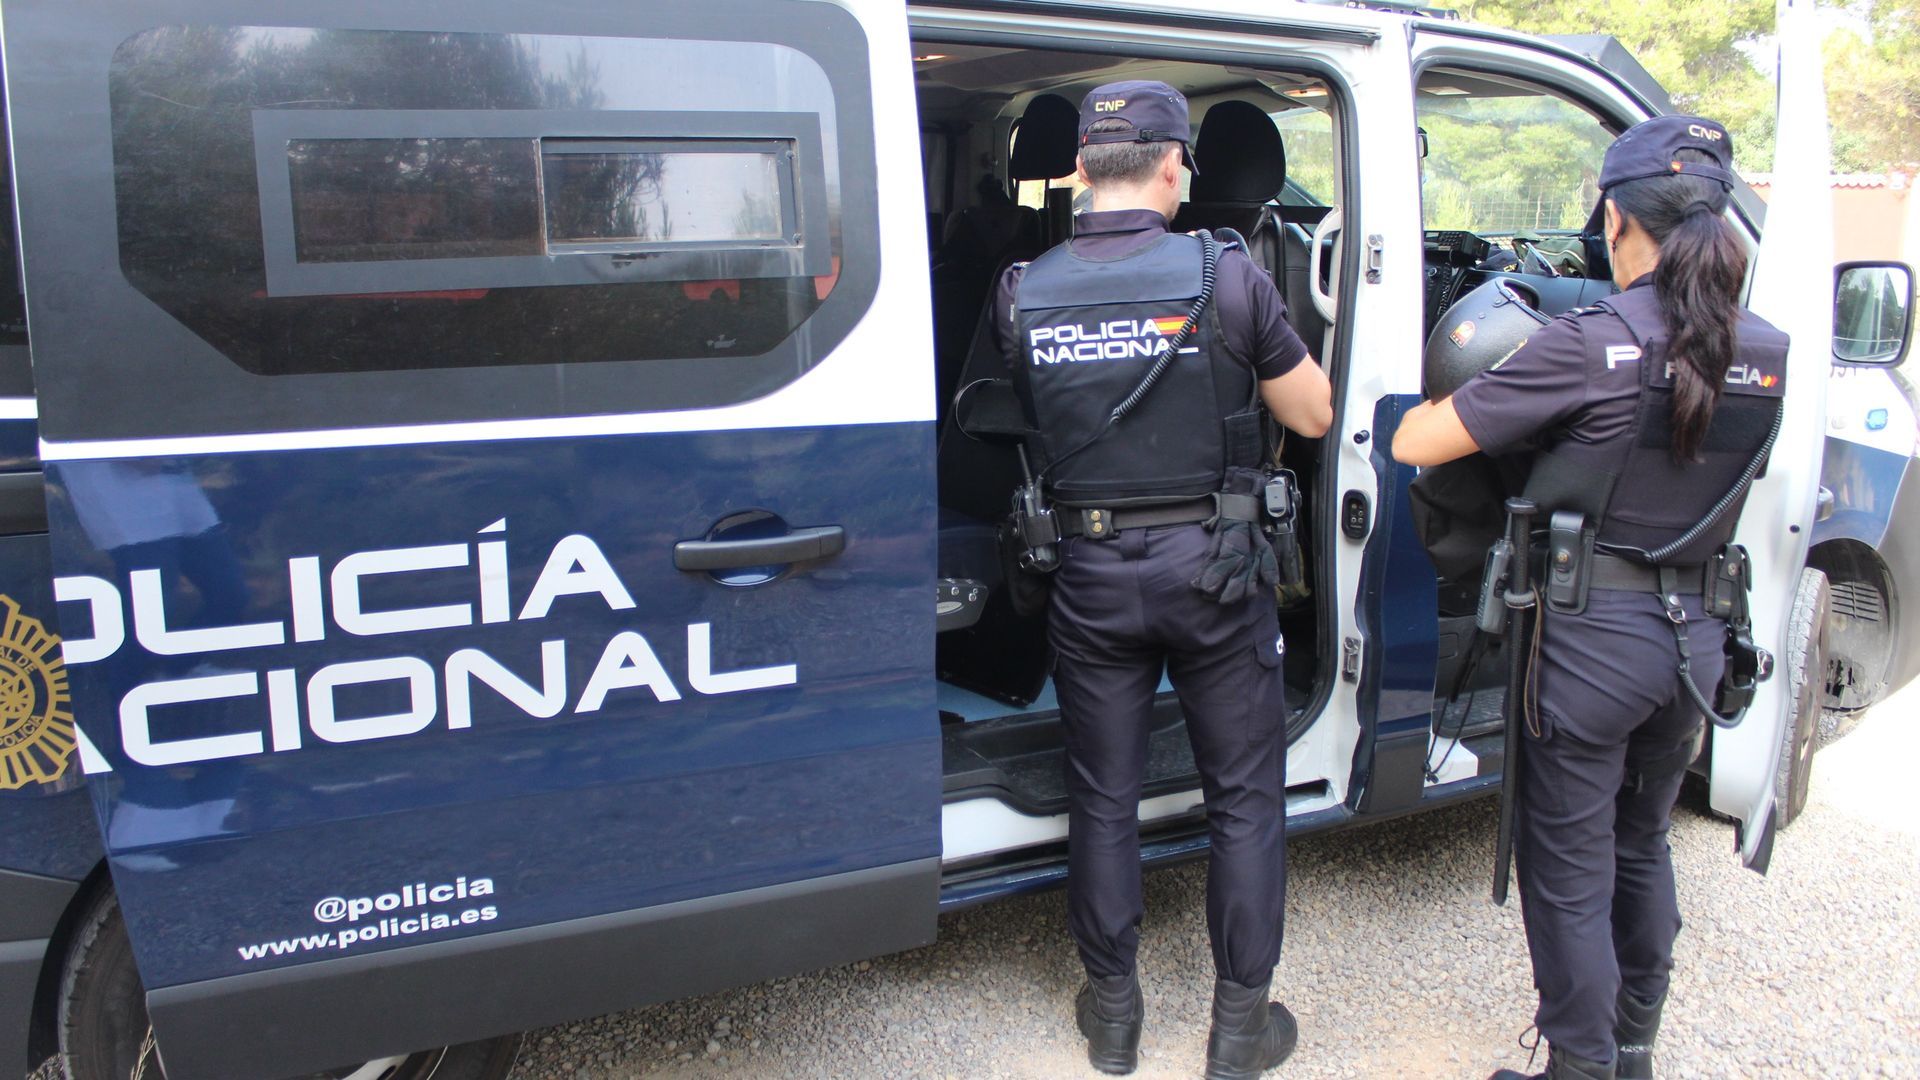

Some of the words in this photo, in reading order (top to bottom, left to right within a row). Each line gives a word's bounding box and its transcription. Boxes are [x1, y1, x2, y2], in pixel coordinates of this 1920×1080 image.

[1094, 99, 1126, 112] CNP
[1688, 124, 1722, 141] CNP
[1030, 318, 1162, 347] POLICIA
[313, 876, 494, 923] @policia
[237, 905, 499, 961] www.policia.es
